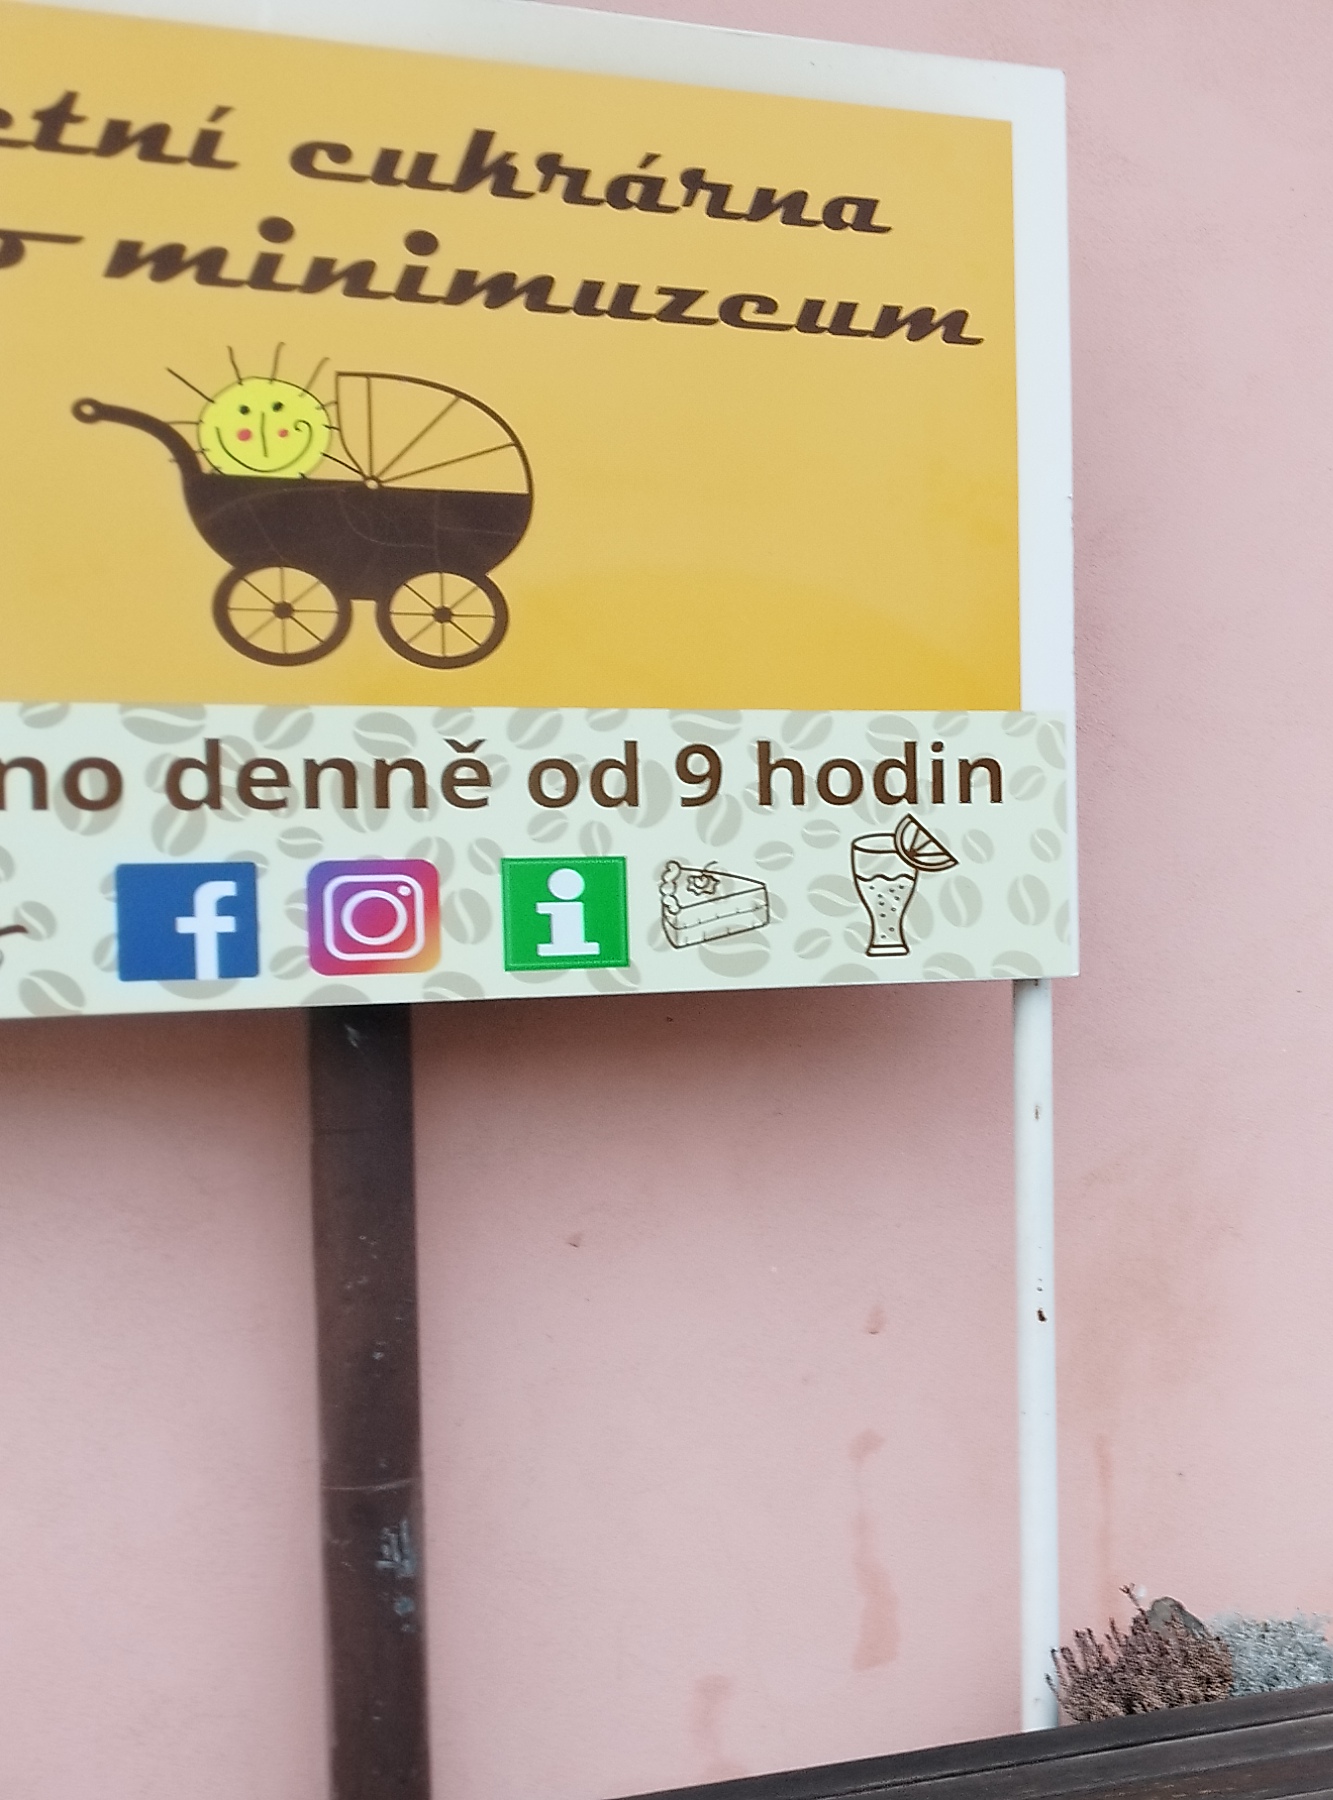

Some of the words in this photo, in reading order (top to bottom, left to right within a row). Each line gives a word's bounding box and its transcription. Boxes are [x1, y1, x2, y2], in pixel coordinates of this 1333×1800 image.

[288, 128, 893, 234] cukrárna
[103, 216, 984, 347] minimuzeum
[165, 737, 492, 811] denně
[527, 740, 639, 809] od
[675, 742, 722, 808] 9
[756, 740, 1004, 806] hodin
